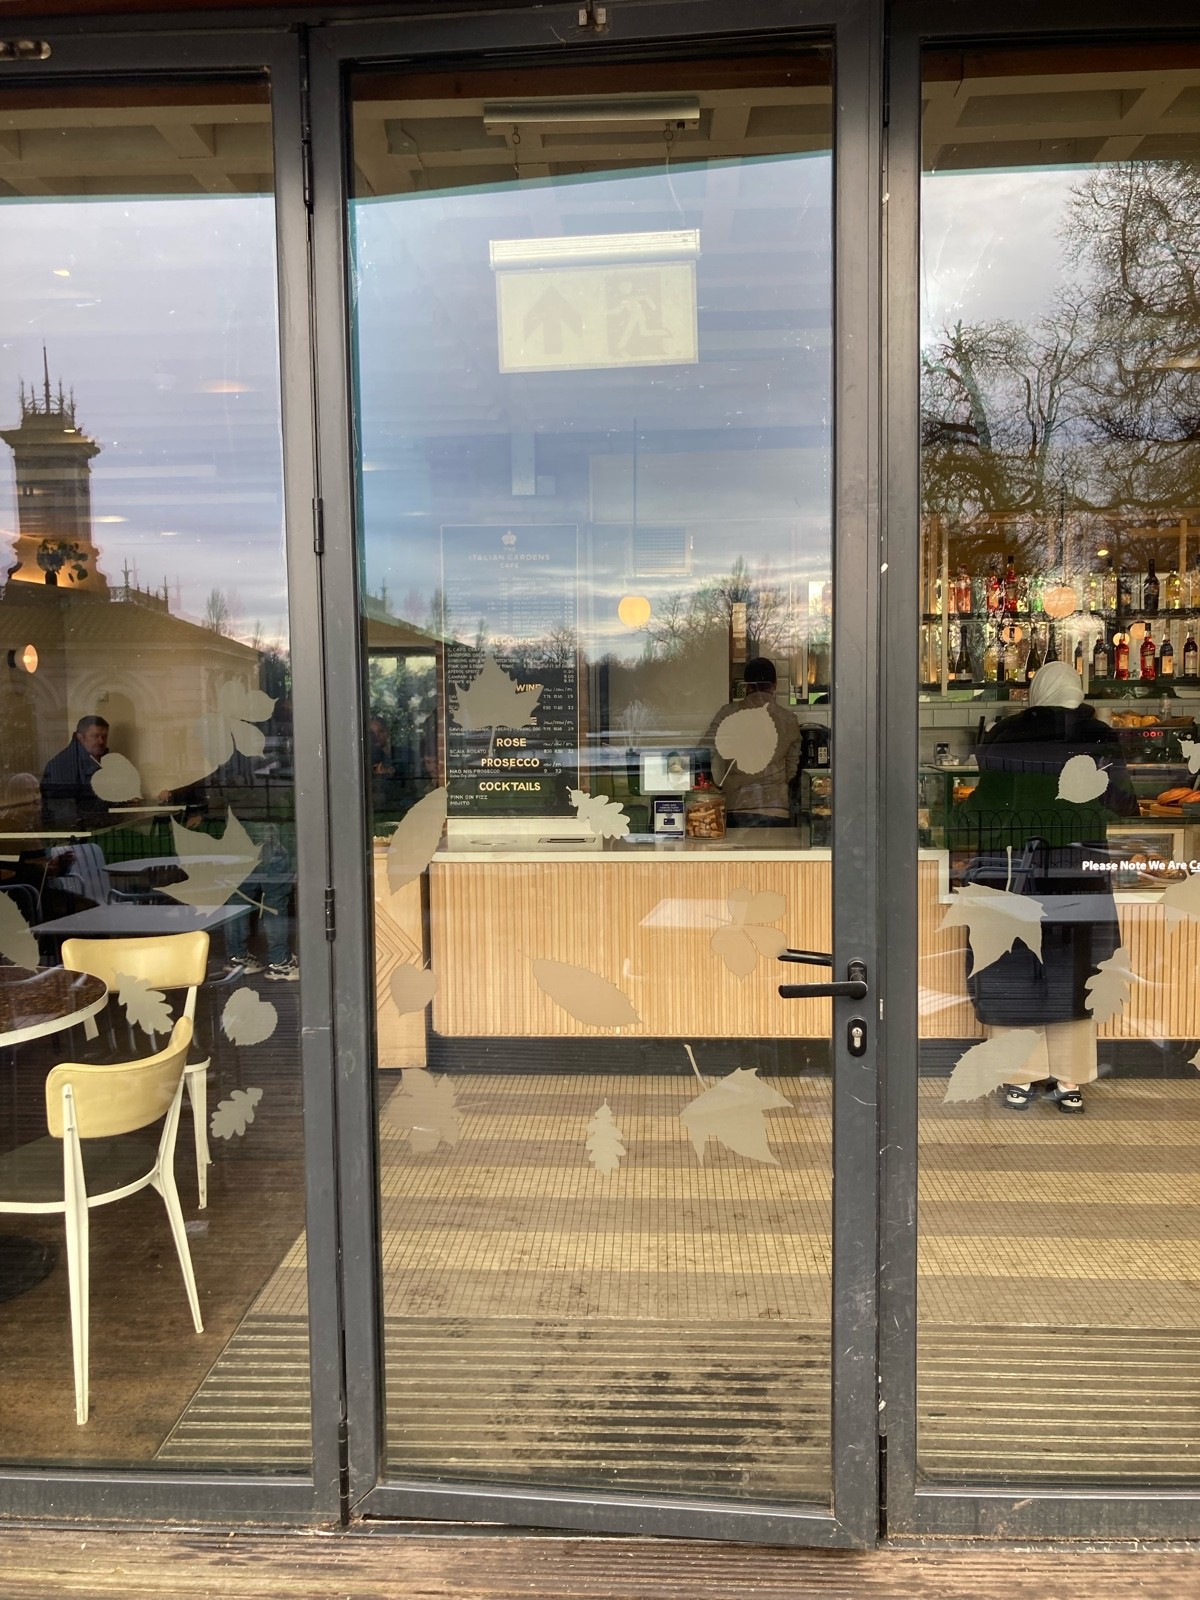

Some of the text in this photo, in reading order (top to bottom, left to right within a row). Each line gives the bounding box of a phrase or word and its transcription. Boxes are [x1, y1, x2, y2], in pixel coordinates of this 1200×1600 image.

[488, 636, 534, 645] ALCOHOL
[496, 738, 527, 747] ROSE
[481, 758, 540, 767] PROSECCO
[479, 782, 541, 791] COCKTAILS
[1082, 860, 1118, 871] Please
[1119, 860, 1147, 870] Note
[1148, 860, 1166, 870] We
[1167, 860, 1187, 870] Are
